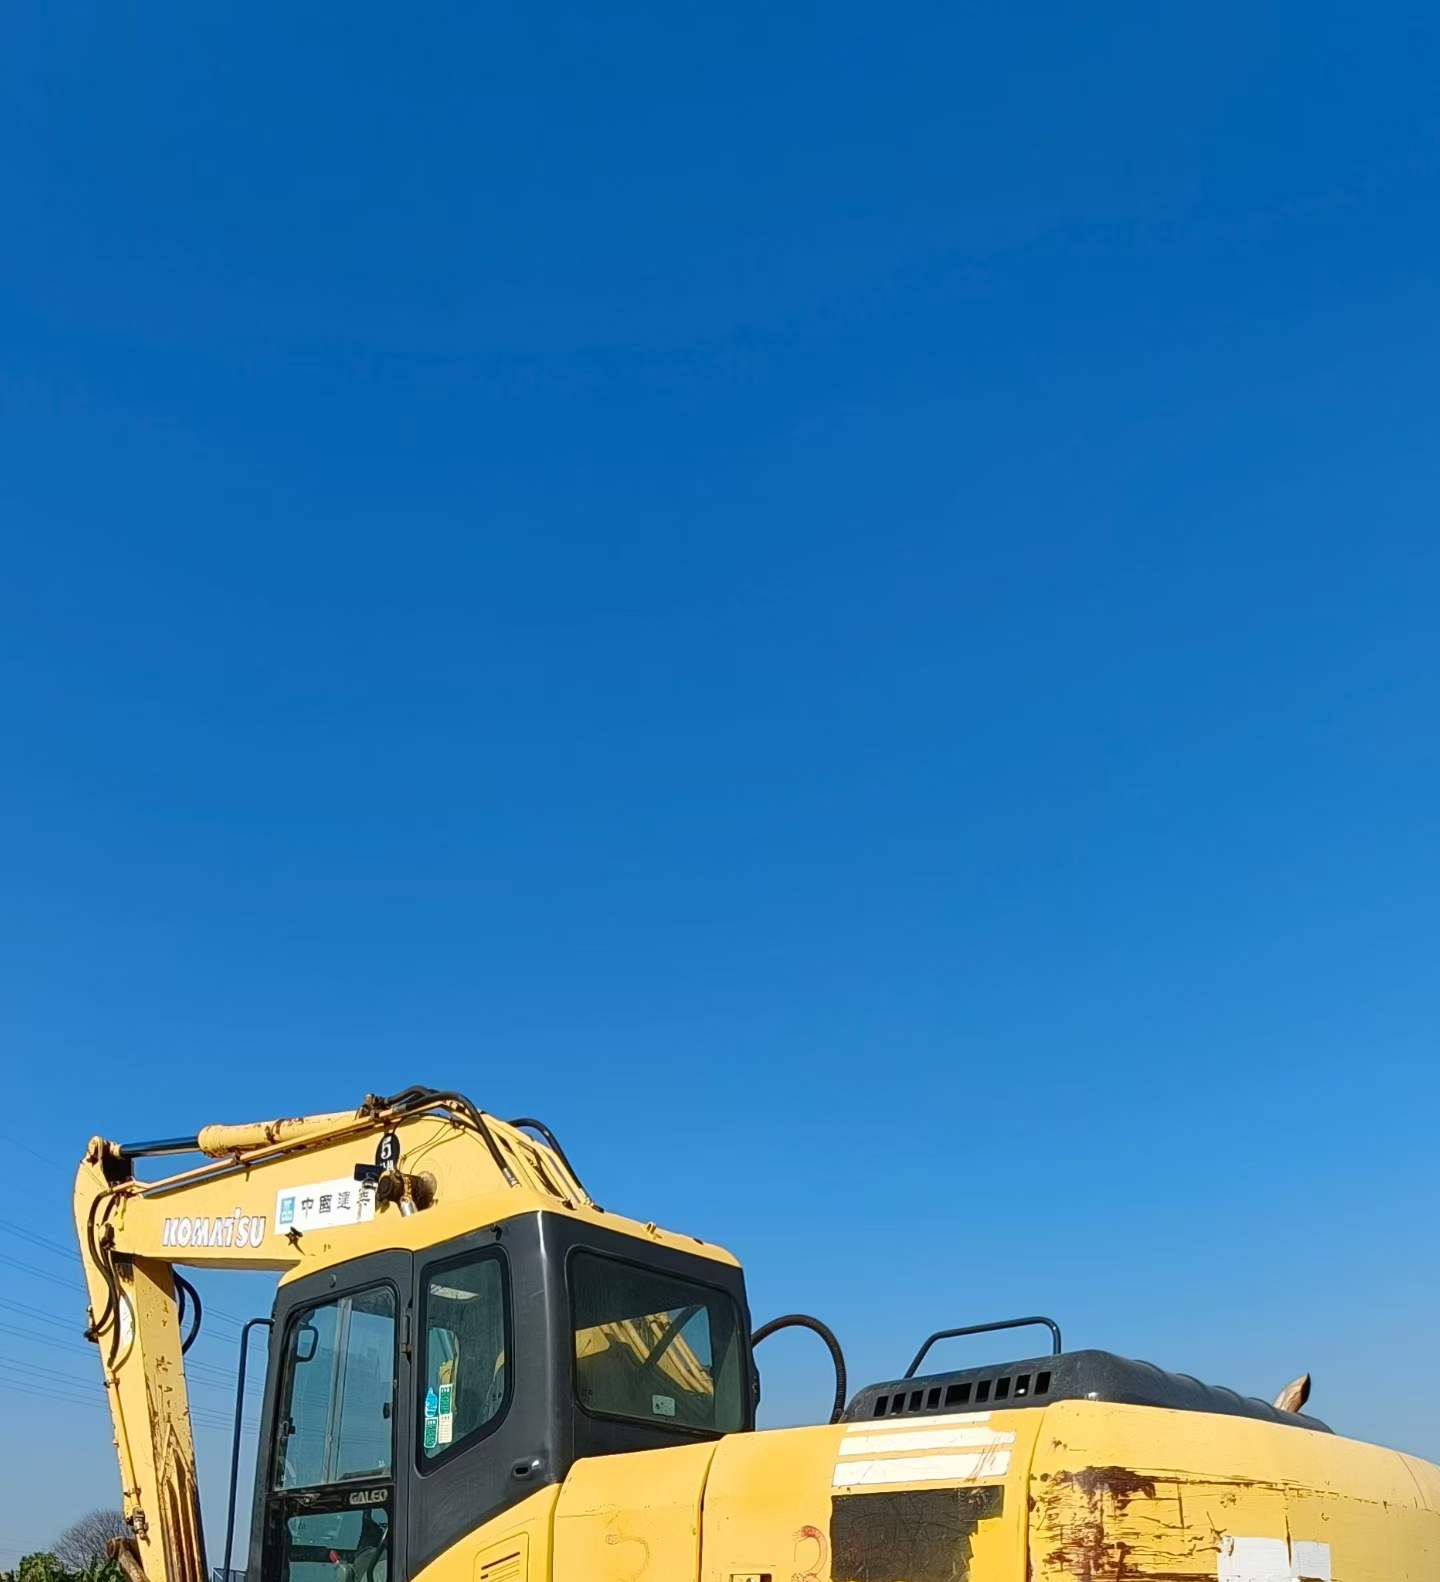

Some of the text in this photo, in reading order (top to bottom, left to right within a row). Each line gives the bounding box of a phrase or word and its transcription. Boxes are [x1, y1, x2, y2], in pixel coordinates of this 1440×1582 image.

[381, 1136, 392, 1160] 5
[162, 1207, 266, 1248] KOMATSU
[349, 1489, 388, 1505] GALEO
